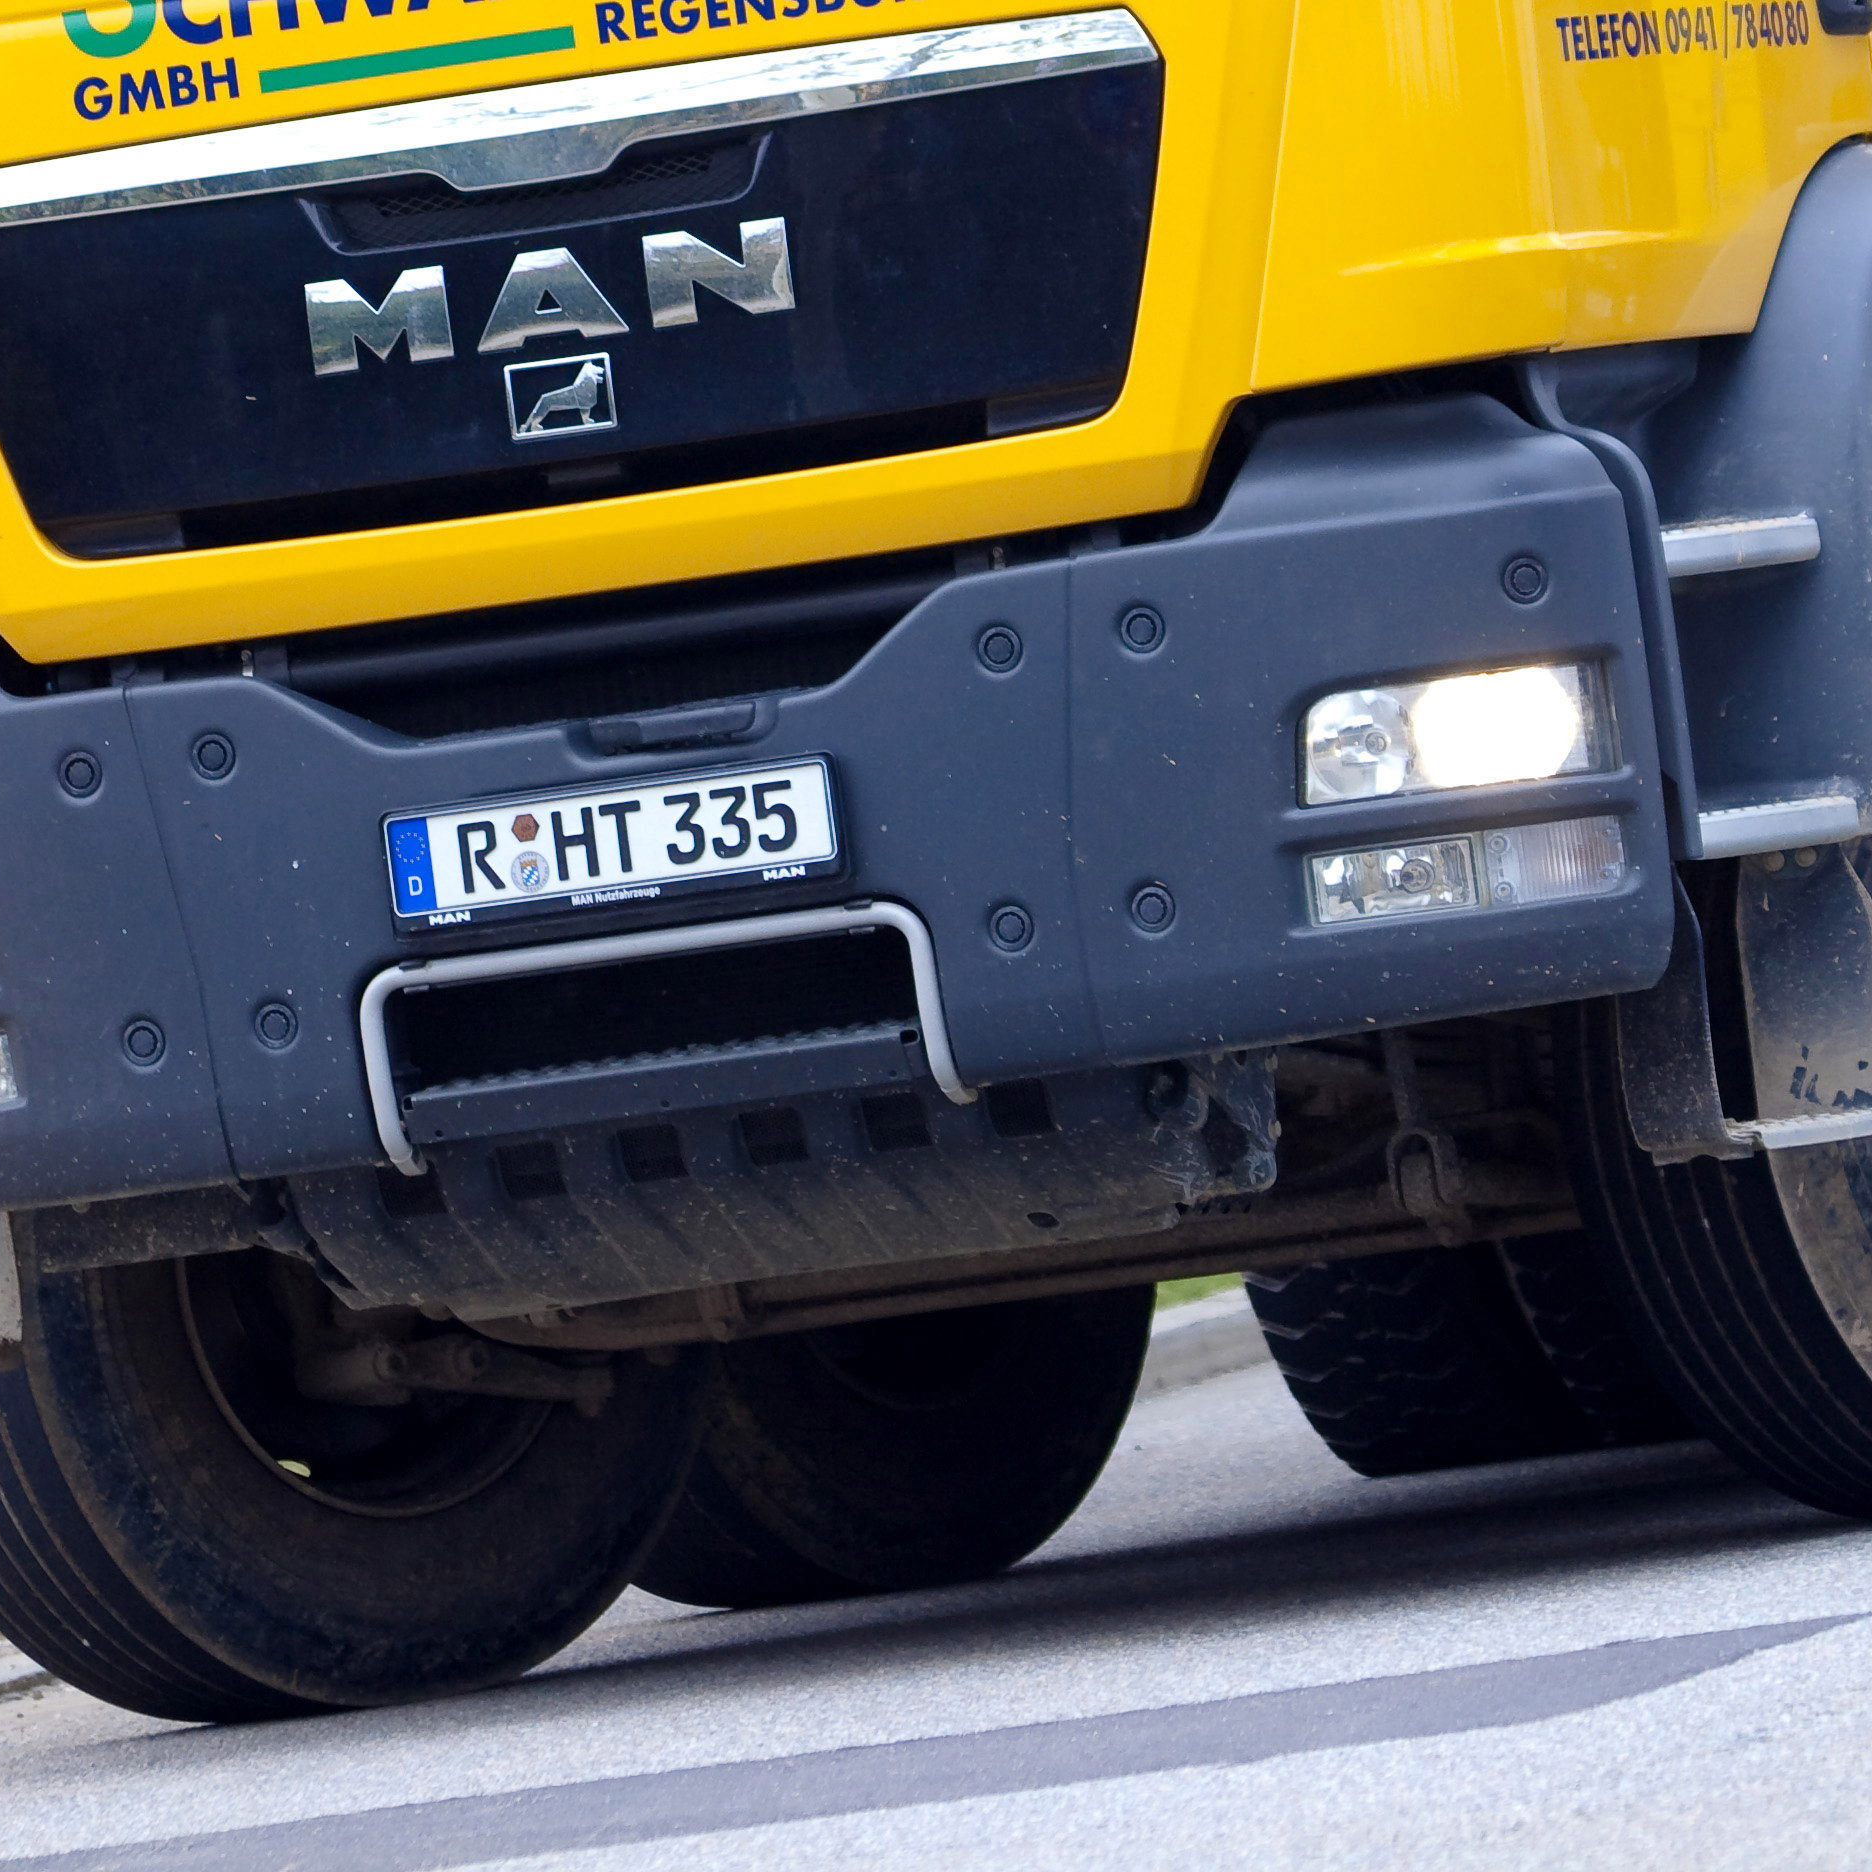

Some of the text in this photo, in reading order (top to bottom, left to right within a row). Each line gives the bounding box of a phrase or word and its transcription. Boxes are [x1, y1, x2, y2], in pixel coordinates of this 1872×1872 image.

[1556, 9, 1661, 62] TELEFON
[74, 57, 240, 121] GMBH
[304, 217, 797, 376] MAN
[457, 820, 506, 894] R
[551, 800, 641, 881] HT
[664, 779, 798, 866] 335
[408, 874, 424, 897] D
[763, 864, 807, 881] MAN
[570, 885, 661, 907] MAN Nutzfahrzeuge
[428, 910, 471, 926] MAN
